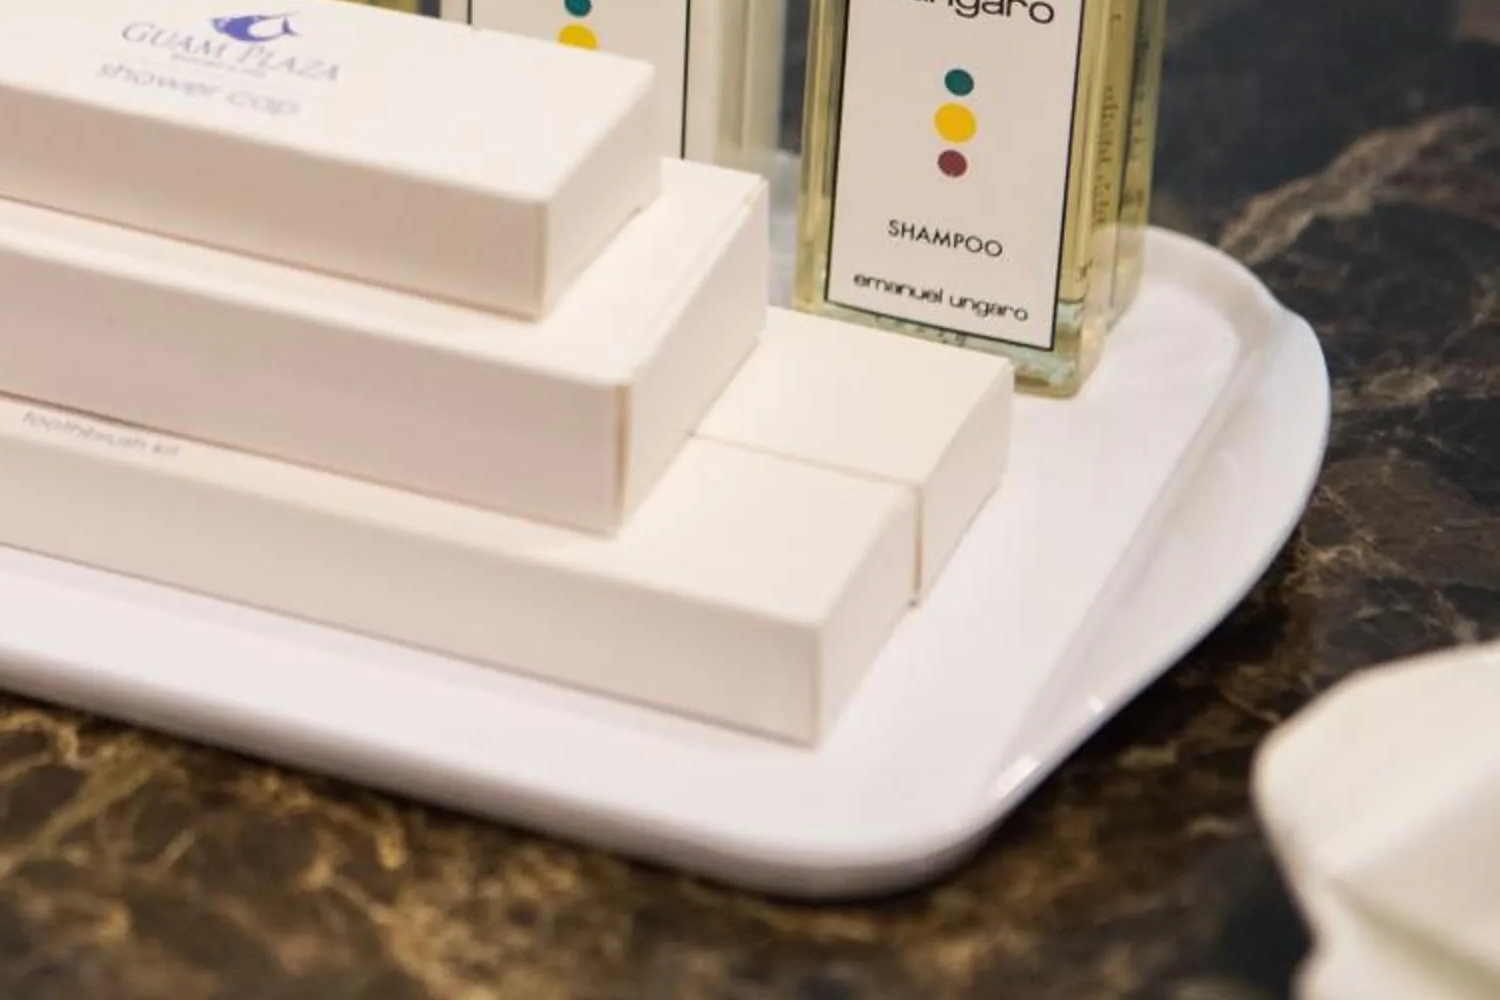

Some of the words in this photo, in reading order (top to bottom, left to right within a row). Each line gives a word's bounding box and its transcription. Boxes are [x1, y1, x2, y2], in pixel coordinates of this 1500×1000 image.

[121, 21, 227, 58] GUAM
[237, 43, 340, 82] PLAZA
[96, 61, 219, 96] shower
[225, 90, 302, 117] cap
[888, 219, 1003, 257] SHAMPOO
[853, 273, 943, 304] emanuel
[949, 294, 1029, 322] ungaro
